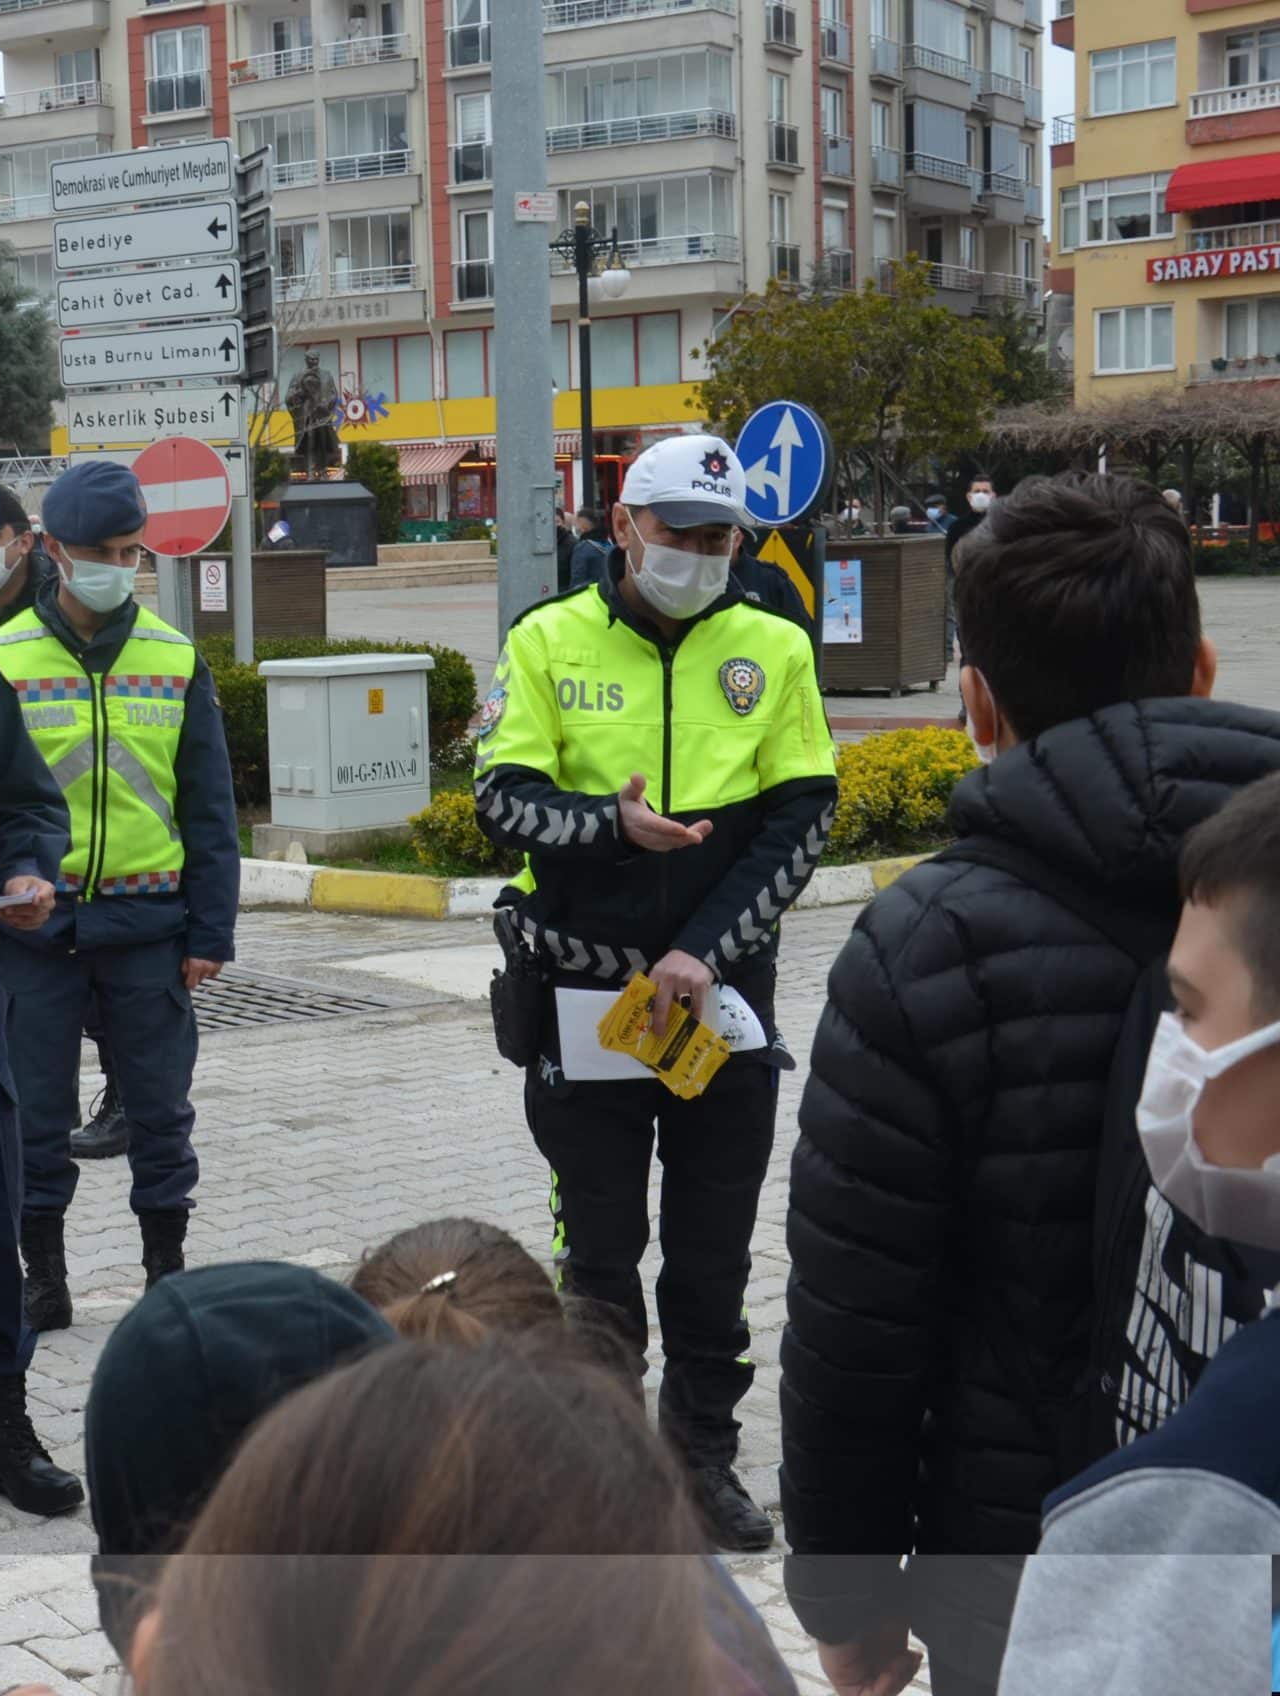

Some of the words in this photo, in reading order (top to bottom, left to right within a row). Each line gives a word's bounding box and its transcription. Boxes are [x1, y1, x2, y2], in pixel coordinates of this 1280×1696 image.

[56, 173, 106, 197] Demokrasi
[108, 178, 120, 190] ve
[122, 164, 180, 187] Cumhuriyet
[183, 157, 227, 182] Meydanı
[58, 233, 133, 253] Belediye
[1152, 253, 1224, 282] SARAY
[61, 295, 105, 312] Cahit
[113, 288, 152, 307] Övet
[162, 282, 200, 301] Cad.
[63, 353, 96, 368] Usta
[105, 349, 153, 364] Burnu
[162, 346, 217, 360] Limanı
[73, 409, 147, 428] Askerlik
[154, 405, 215, 430] Şubesi
